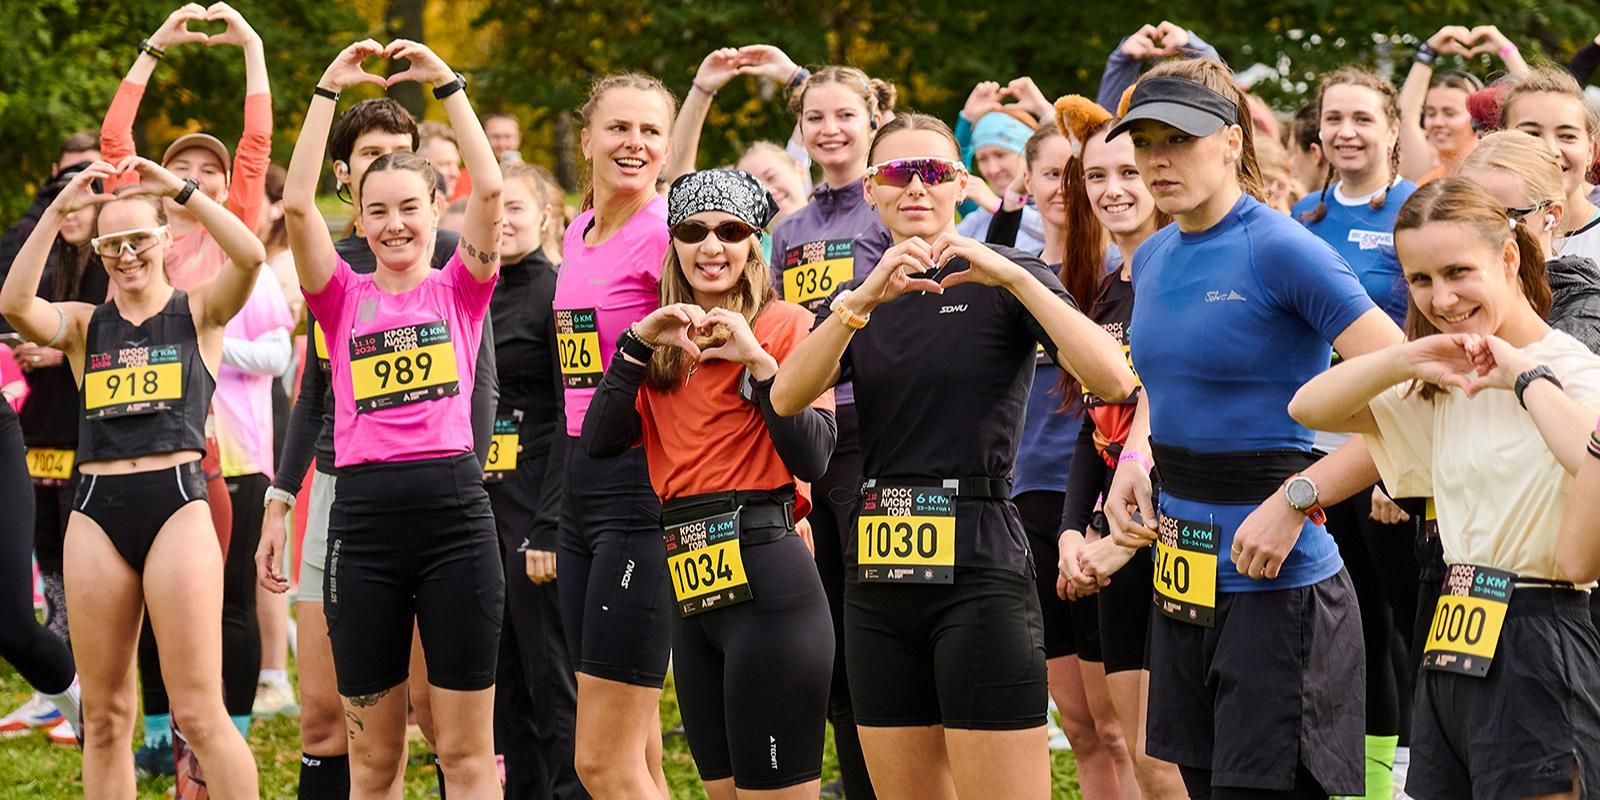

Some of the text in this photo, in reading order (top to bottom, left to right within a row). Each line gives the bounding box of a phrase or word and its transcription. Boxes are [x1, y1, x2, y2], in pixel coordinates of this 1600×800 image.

[796, 265, 833, 298] 936
[384, 326, 417, 341] КРОСС
[420, 327, 428, 337] 6
[354, 345, 377, 356] 2026
[559, 338, 592, 369] 026
[374, 352, 432, 390] 989
[106, 370, 159, 400] 918
[488, 440, 500, 465] 3
[882, 488, 913, 498] КРОСС
[916, 493, 926, 504] 6
[880, 498, 912, 508] ЛИСЬЯ
[887, 507, 912, 517] ГОРА
[679, 521, 707, 536] КРОСС
[708, 523, 716, 534] 6
[1181, 526, 1191, 538] 6
[680, 530, 708, 546] ЛИСЬЯ
[866, 522, 938, 559] 1030
[688, 539, 709, 552] ГОРА
[674, 548, 733, 594] 1034
[1475, 572, 1485, 585] 6
